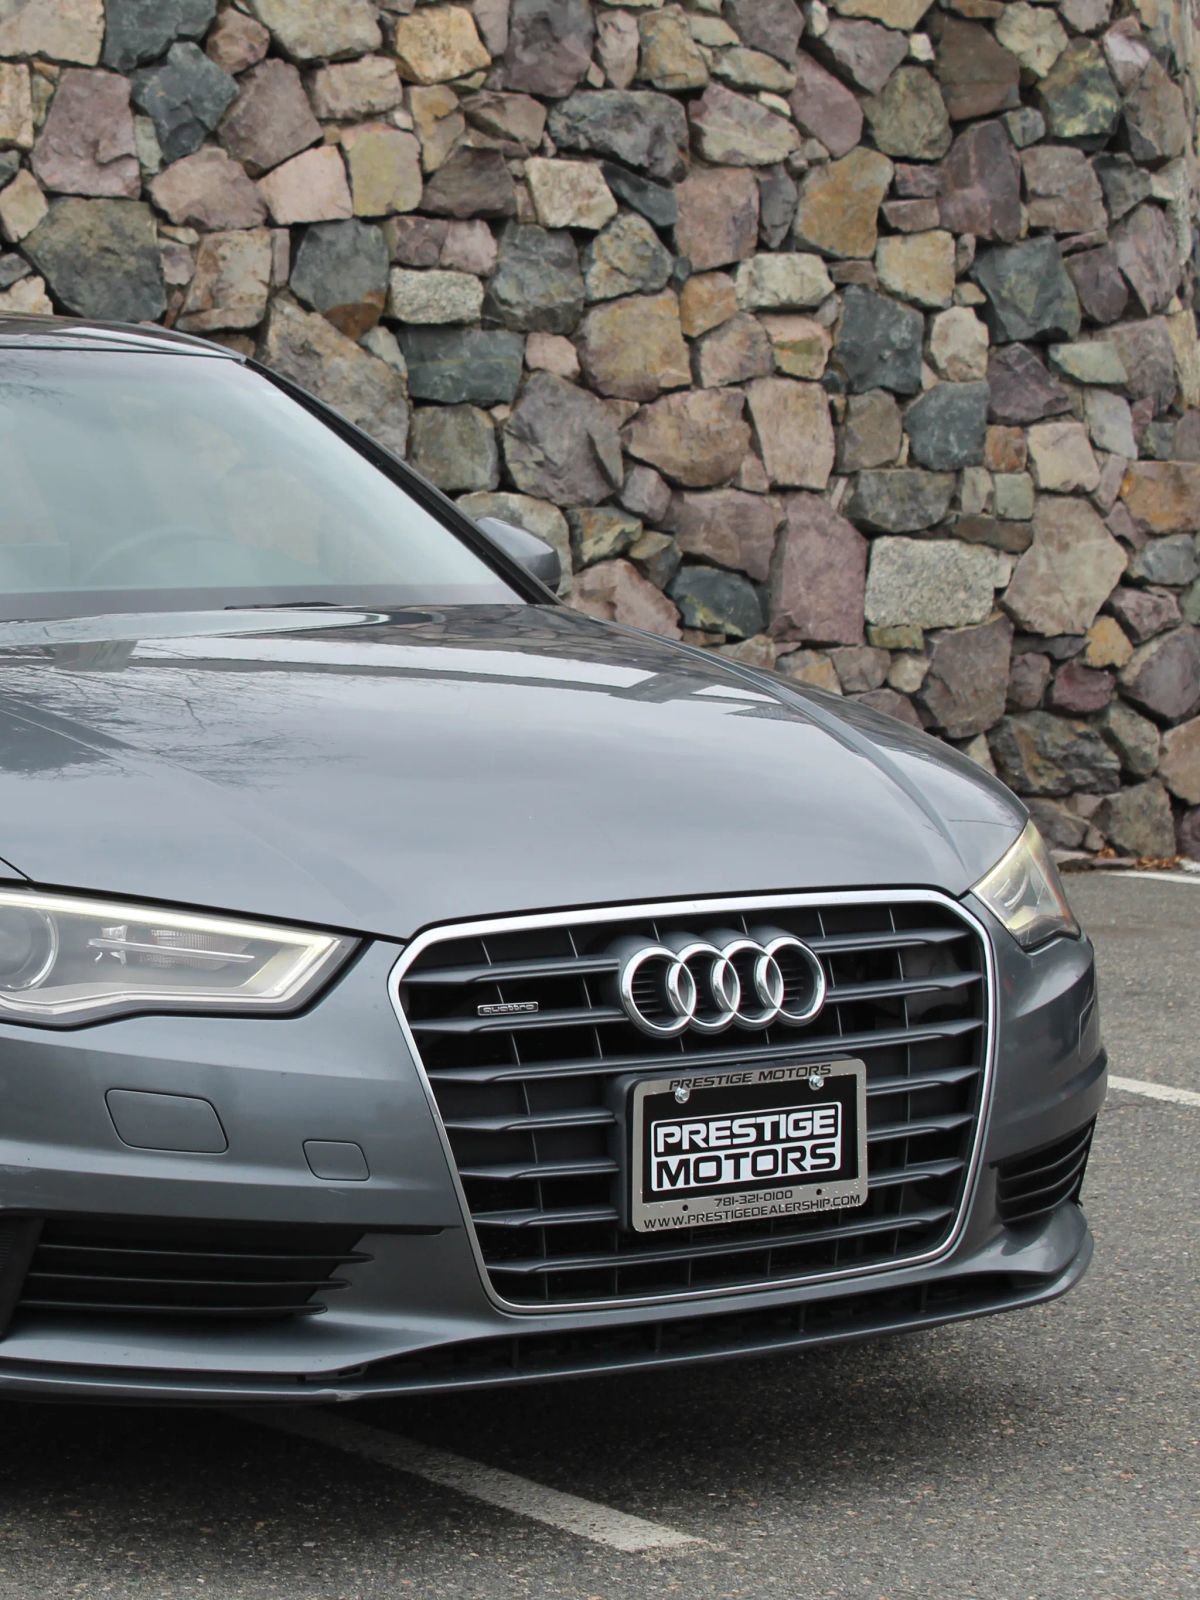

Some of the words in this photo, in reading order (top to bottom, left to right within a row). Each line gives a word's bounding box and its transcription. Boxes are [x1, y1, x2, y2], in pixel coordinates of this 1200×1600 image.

[483, 1004, 534, 1014] quattro
[669, 1072, 753, 1091] PRESTIGE
[758, 1064, 832, 1083] MOTORS
[657, 1109, 835, 1152] PRESTIGE
[656, 1141, 836, 1189] MOTORS
[644, 1194, 861, 1230] WWW.PRESTIGEDEALERSHIP.COM
[714, 1190, 793, 1207] 781-321-0100
